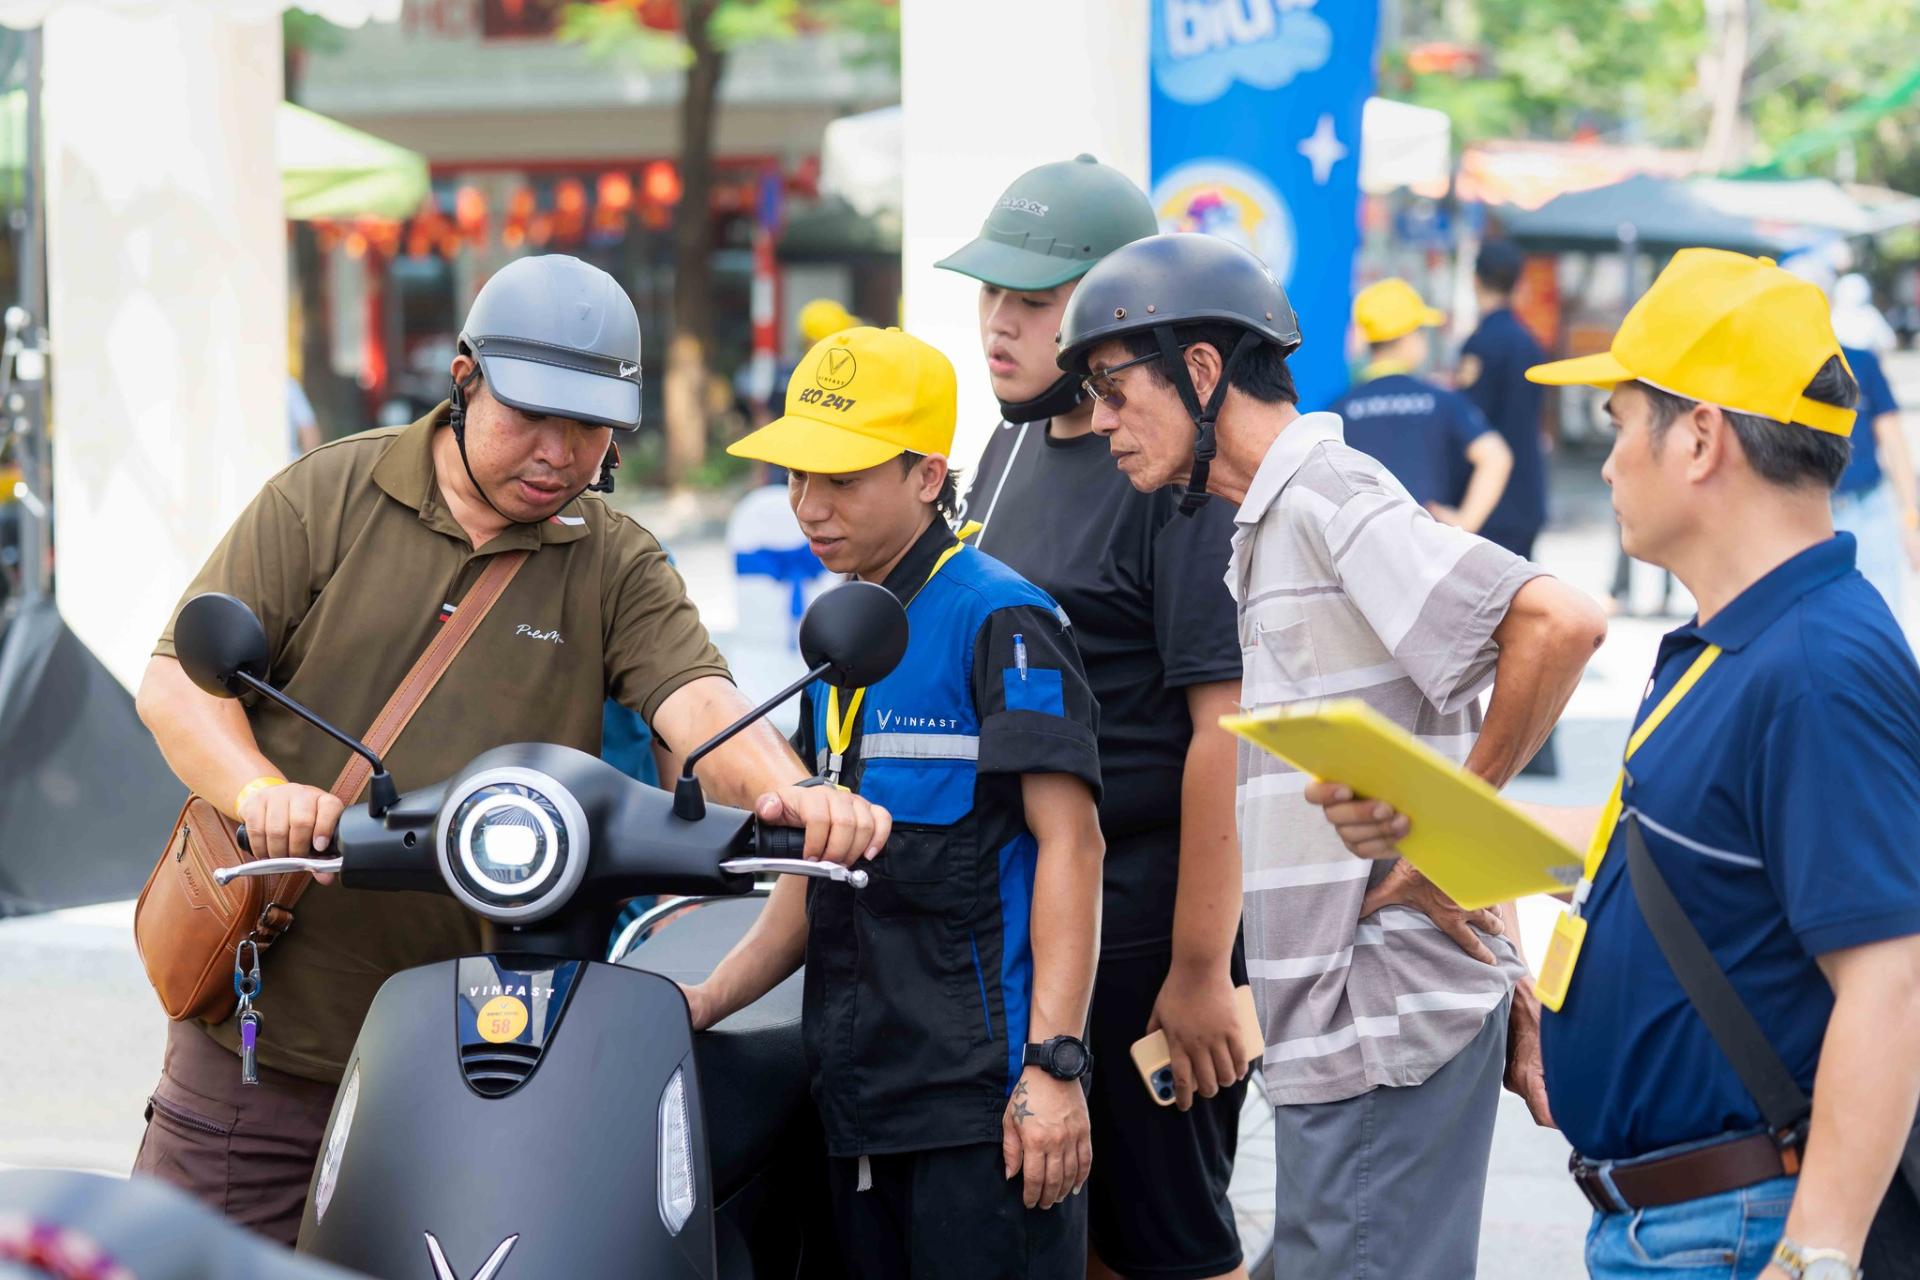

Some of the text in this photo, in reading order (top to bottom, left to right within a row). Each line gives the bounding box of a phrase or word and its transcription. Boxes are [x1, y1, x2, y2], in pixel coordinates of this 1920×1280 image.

[799, 388, 856, 412] ECO 247
[895, 716, 957, 729] VINFAST
[470, 984, 554, 998] VINFAST
[491, 1019, 510, 1034] 58
